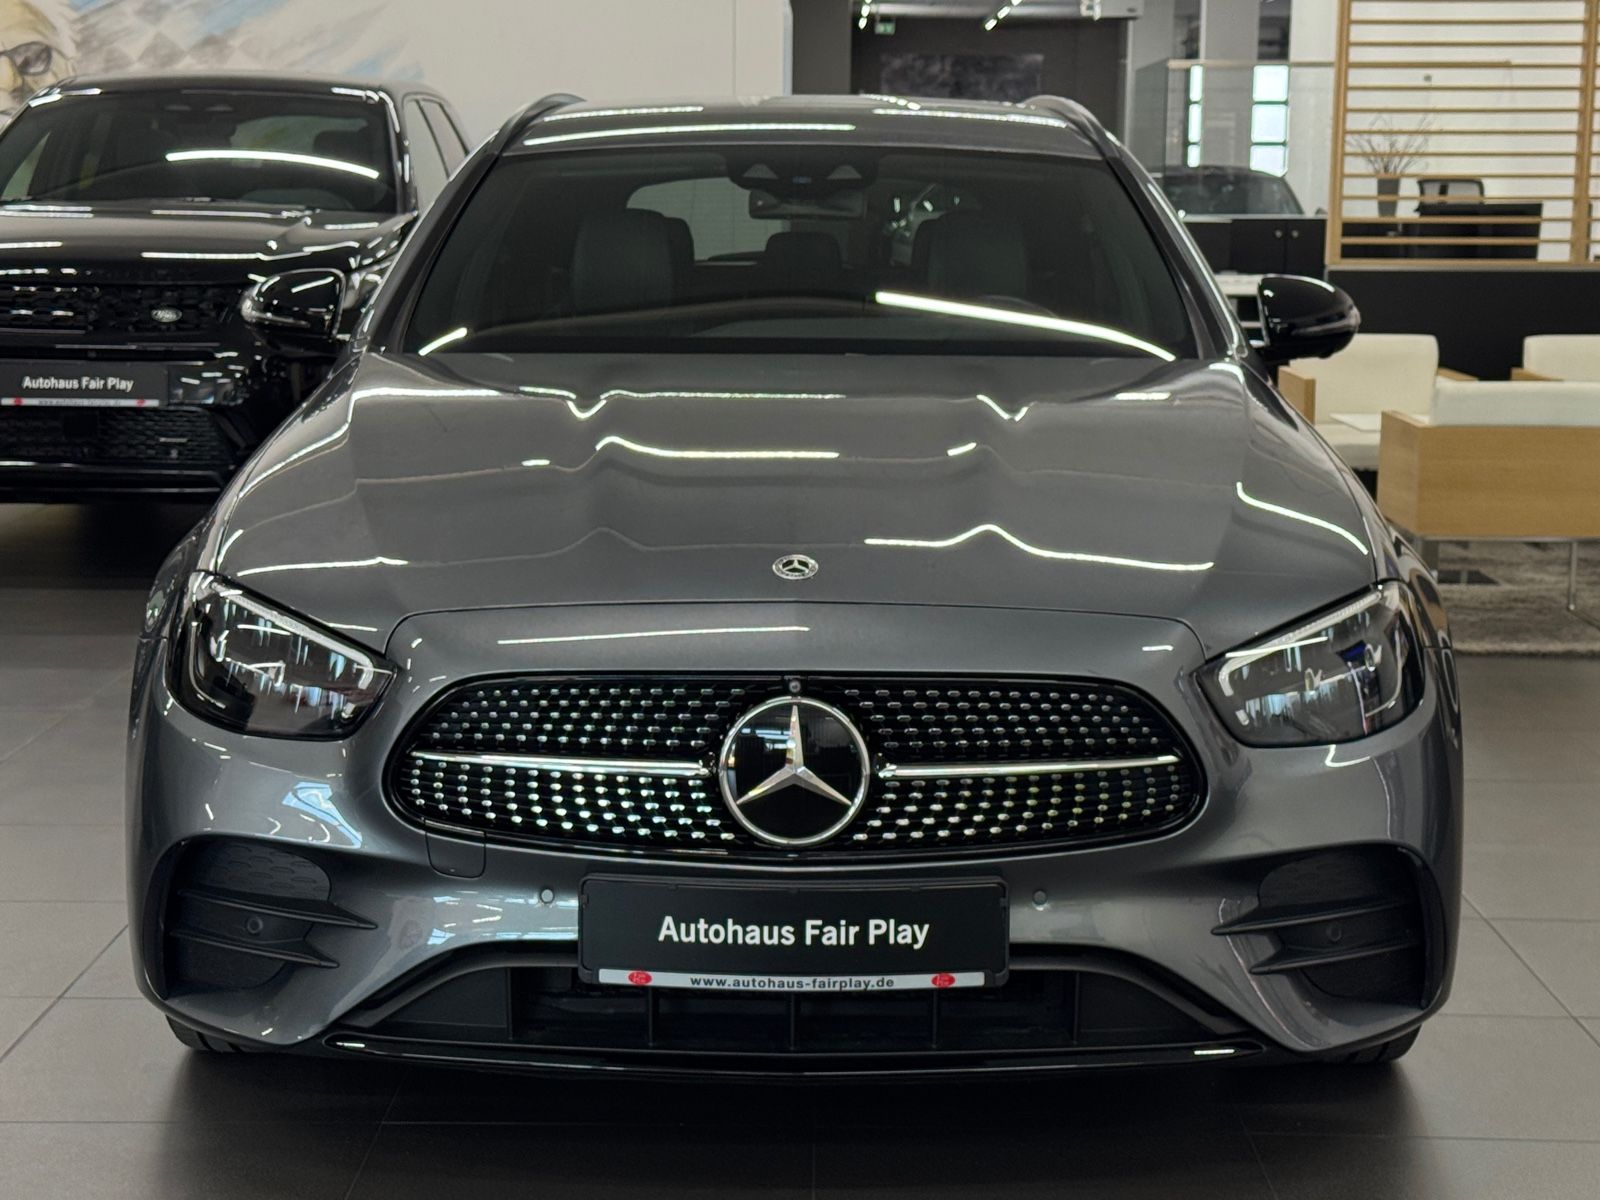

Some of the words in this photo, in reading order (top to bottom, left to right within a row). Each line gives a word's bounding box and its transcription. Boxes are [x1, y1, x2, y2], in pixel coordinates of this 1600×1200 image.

[22, 376, 79, 389] Autohaus
[81, 377, 105, 389] Fair
[107, 377, 134, 392] Play
[658, 916, 796, 946] Autohaus
[805, 919, 860, 946] Fair
[868, 919, 930, 950] Play
[690, 977, 894, 991] www.autohaus-fairplay.de
